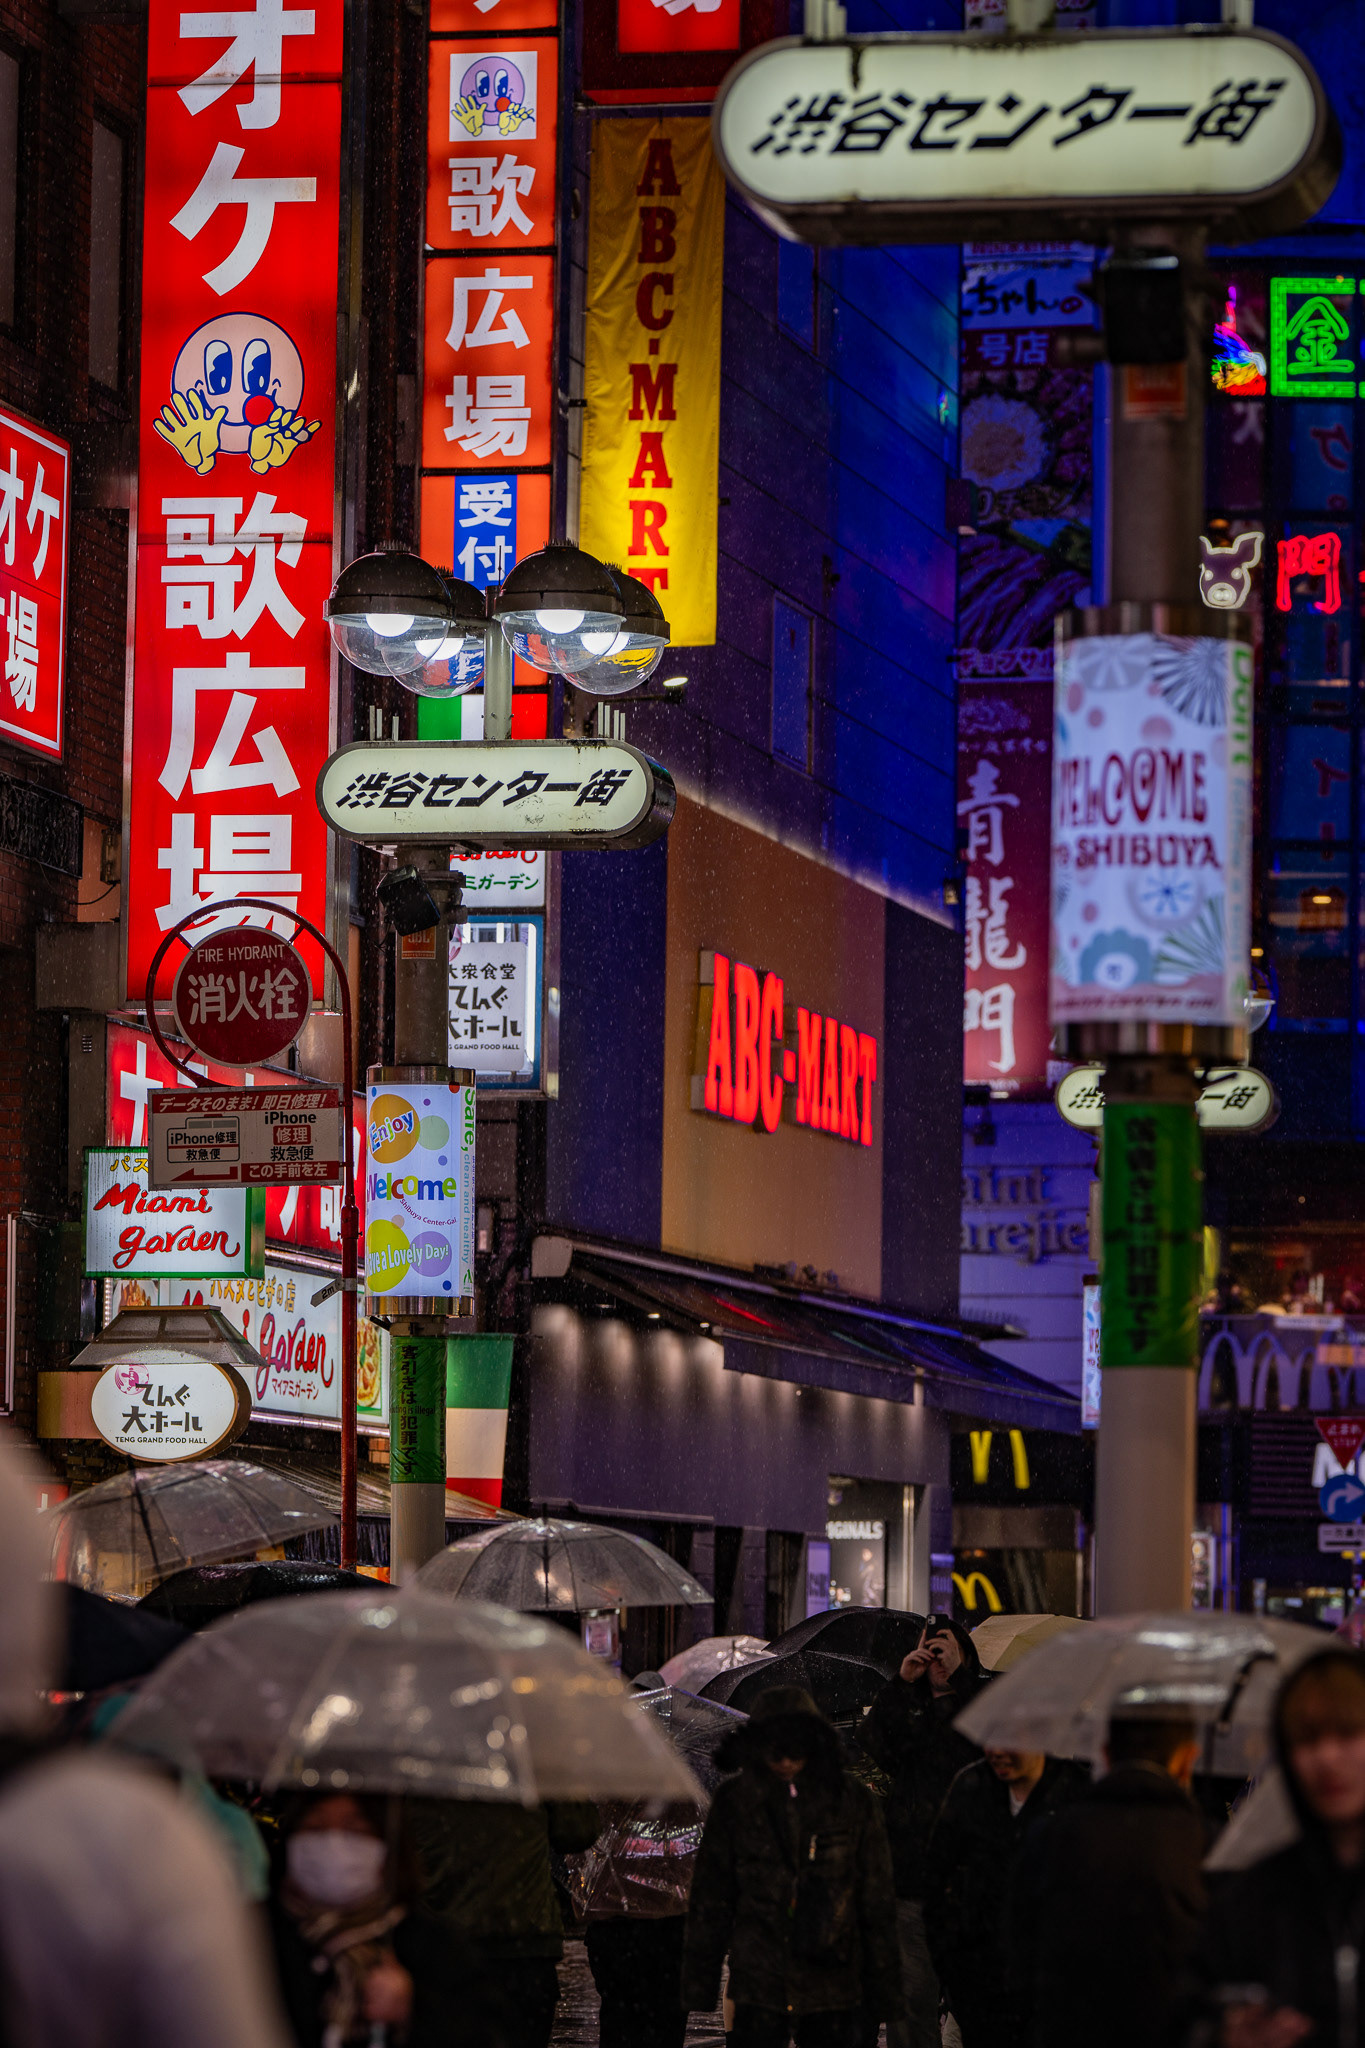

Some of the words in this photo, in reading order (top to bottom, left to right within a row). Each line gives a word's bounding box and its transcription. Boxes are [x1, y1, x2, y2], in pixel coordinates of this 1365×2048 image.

[750, 78, 1288, 156] 渋谷センター街
[444, 153, 536, 459] 歌広場
[961, 331, 1049, 366] 号店
[0, 590, 39, 713] 場
[155, 490, 309, 946] 歌広場
[335, 768, 633, 809] 渋谷センター街
[197, 948, 224, 963] FIRE
[228, 944, 285, 961] HYDRANT
[187, 967, 299, 1025] 消火栓
[449, 985, 508, 1010] てんぐ
[704, 952, 877, 1147] ABC-MART
[264, 1111, 317, 1125] iPhone
[170, 1131, 237, 1145] iPhone修理
[276, 1126, 309, 1144] 修理
[368, 1110, 414, 1154] Enjoy
[186, 1148, 221, 1161] 救急便
[270, 1145, 314, 1162] 救急便
[249, 1162, 327, 1179] この手前を左
[93, 1182, 213, 1215] Miami
[367, 1172, 457, 1202] Welcome
[399, 1198, 422, 1221] Shibuya
[463, 1190, 471, 1214] and
[462, 1216, 471, 1264] healthy
[387, 1243, 423, 1268] Lovely
[425, 1243, 449, 1261] Day!
[321, 1286, 335, 1300] 2m
[135, 1383, 190, 1408] てんぐ
[270, 1377, 320, 1400] マイアミガーデン
[121, 1405, 203, 1434] 大ホール
[414, 1405, 436, 1416] illegal
[115, 1436, 136, 1444] TENG
[137, 1436, 164, 1444] GRAND
[165, 1436, 187, 1444] FOOD
[188, 1436, 208, 1445] HALL
